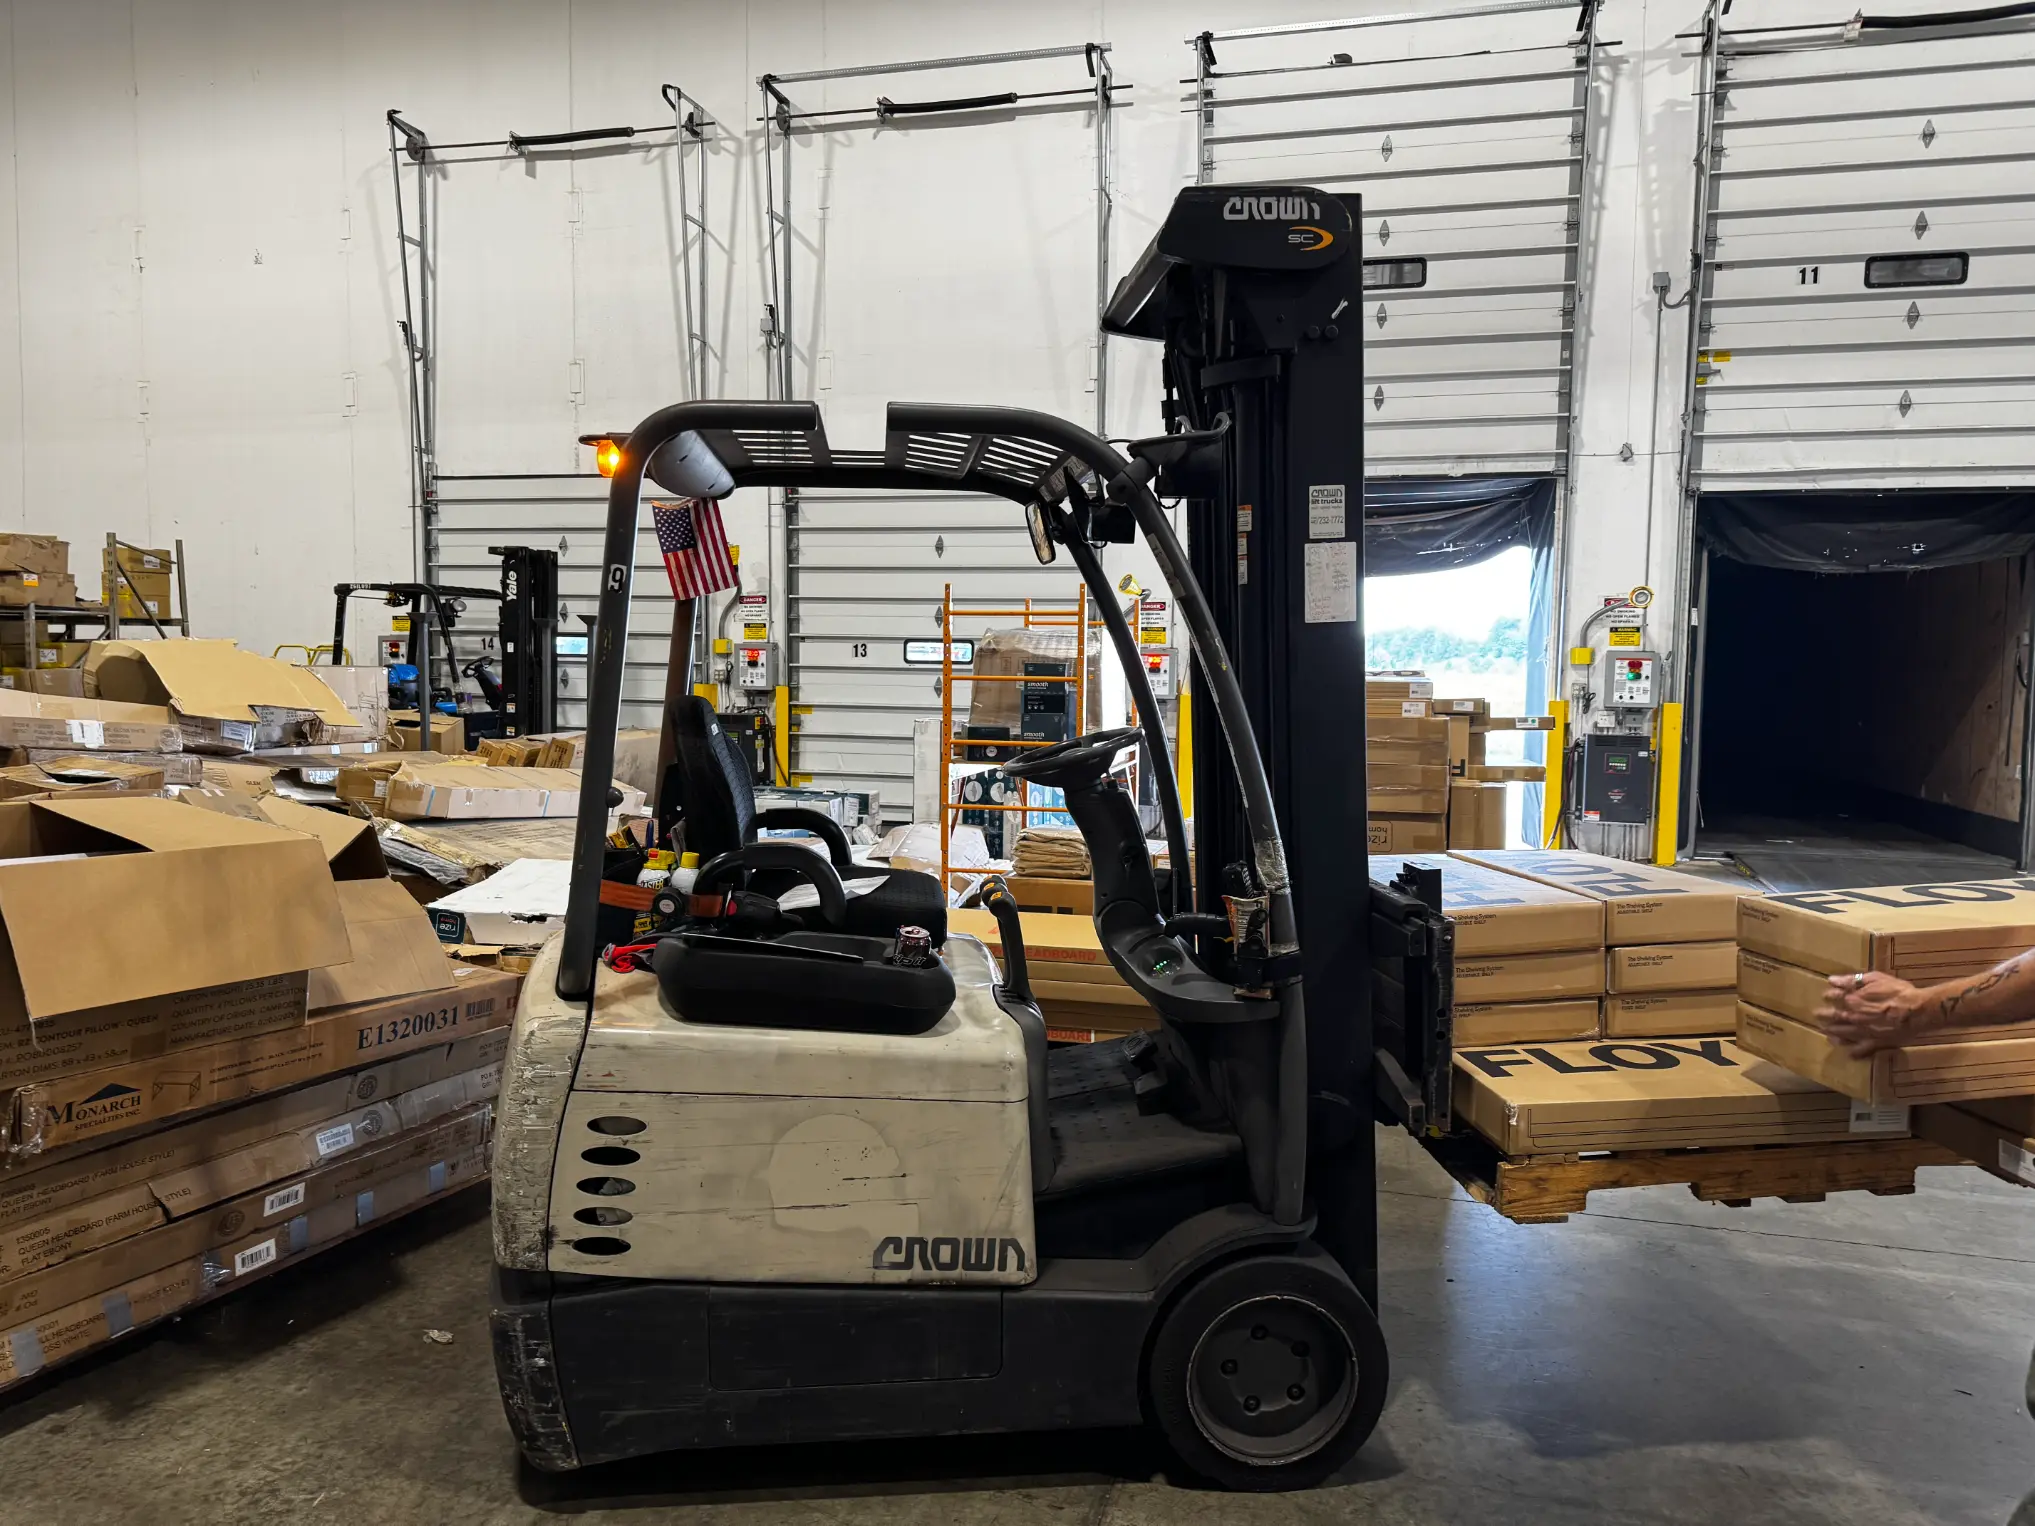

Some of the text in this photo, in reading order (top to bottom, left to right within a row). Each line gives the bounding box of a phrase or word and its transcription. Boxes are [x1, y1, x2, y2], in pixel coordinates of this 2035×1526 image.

[1223, 196, 1321, 221] CROWN
[1287, 234, 1314, 243] SC
[1798, 267, 1820, 285] 11
[1310, 488, 1343, 498] CROWN
[506, 570, 517, 601] Yale
[481, 637, 495, 651] 14
[853, 643, 867, 658] 13
[1025, 946, 1097, 962] EADBOARD
[268, 976, 284, 986] LBS
[126, 1012, 159, 1028] QUEEN
[357, 1005, 460, 1051] E1320031
[1455, 1040, 1740, 1078] FLOY
[46, 1095, 142, 1128] MONARCH
[18, 1239, 50, 1256] QUEEN
[51, 1219, 104, 1243] HEADBOARD
[105, 1208, 131, 1227] (FARM
[21, 1239, 73, 1267] FLAT EBONY
[873, 1236, 1026, 1272] CROWN
[63, 1329, 92, 1347] WHITE
